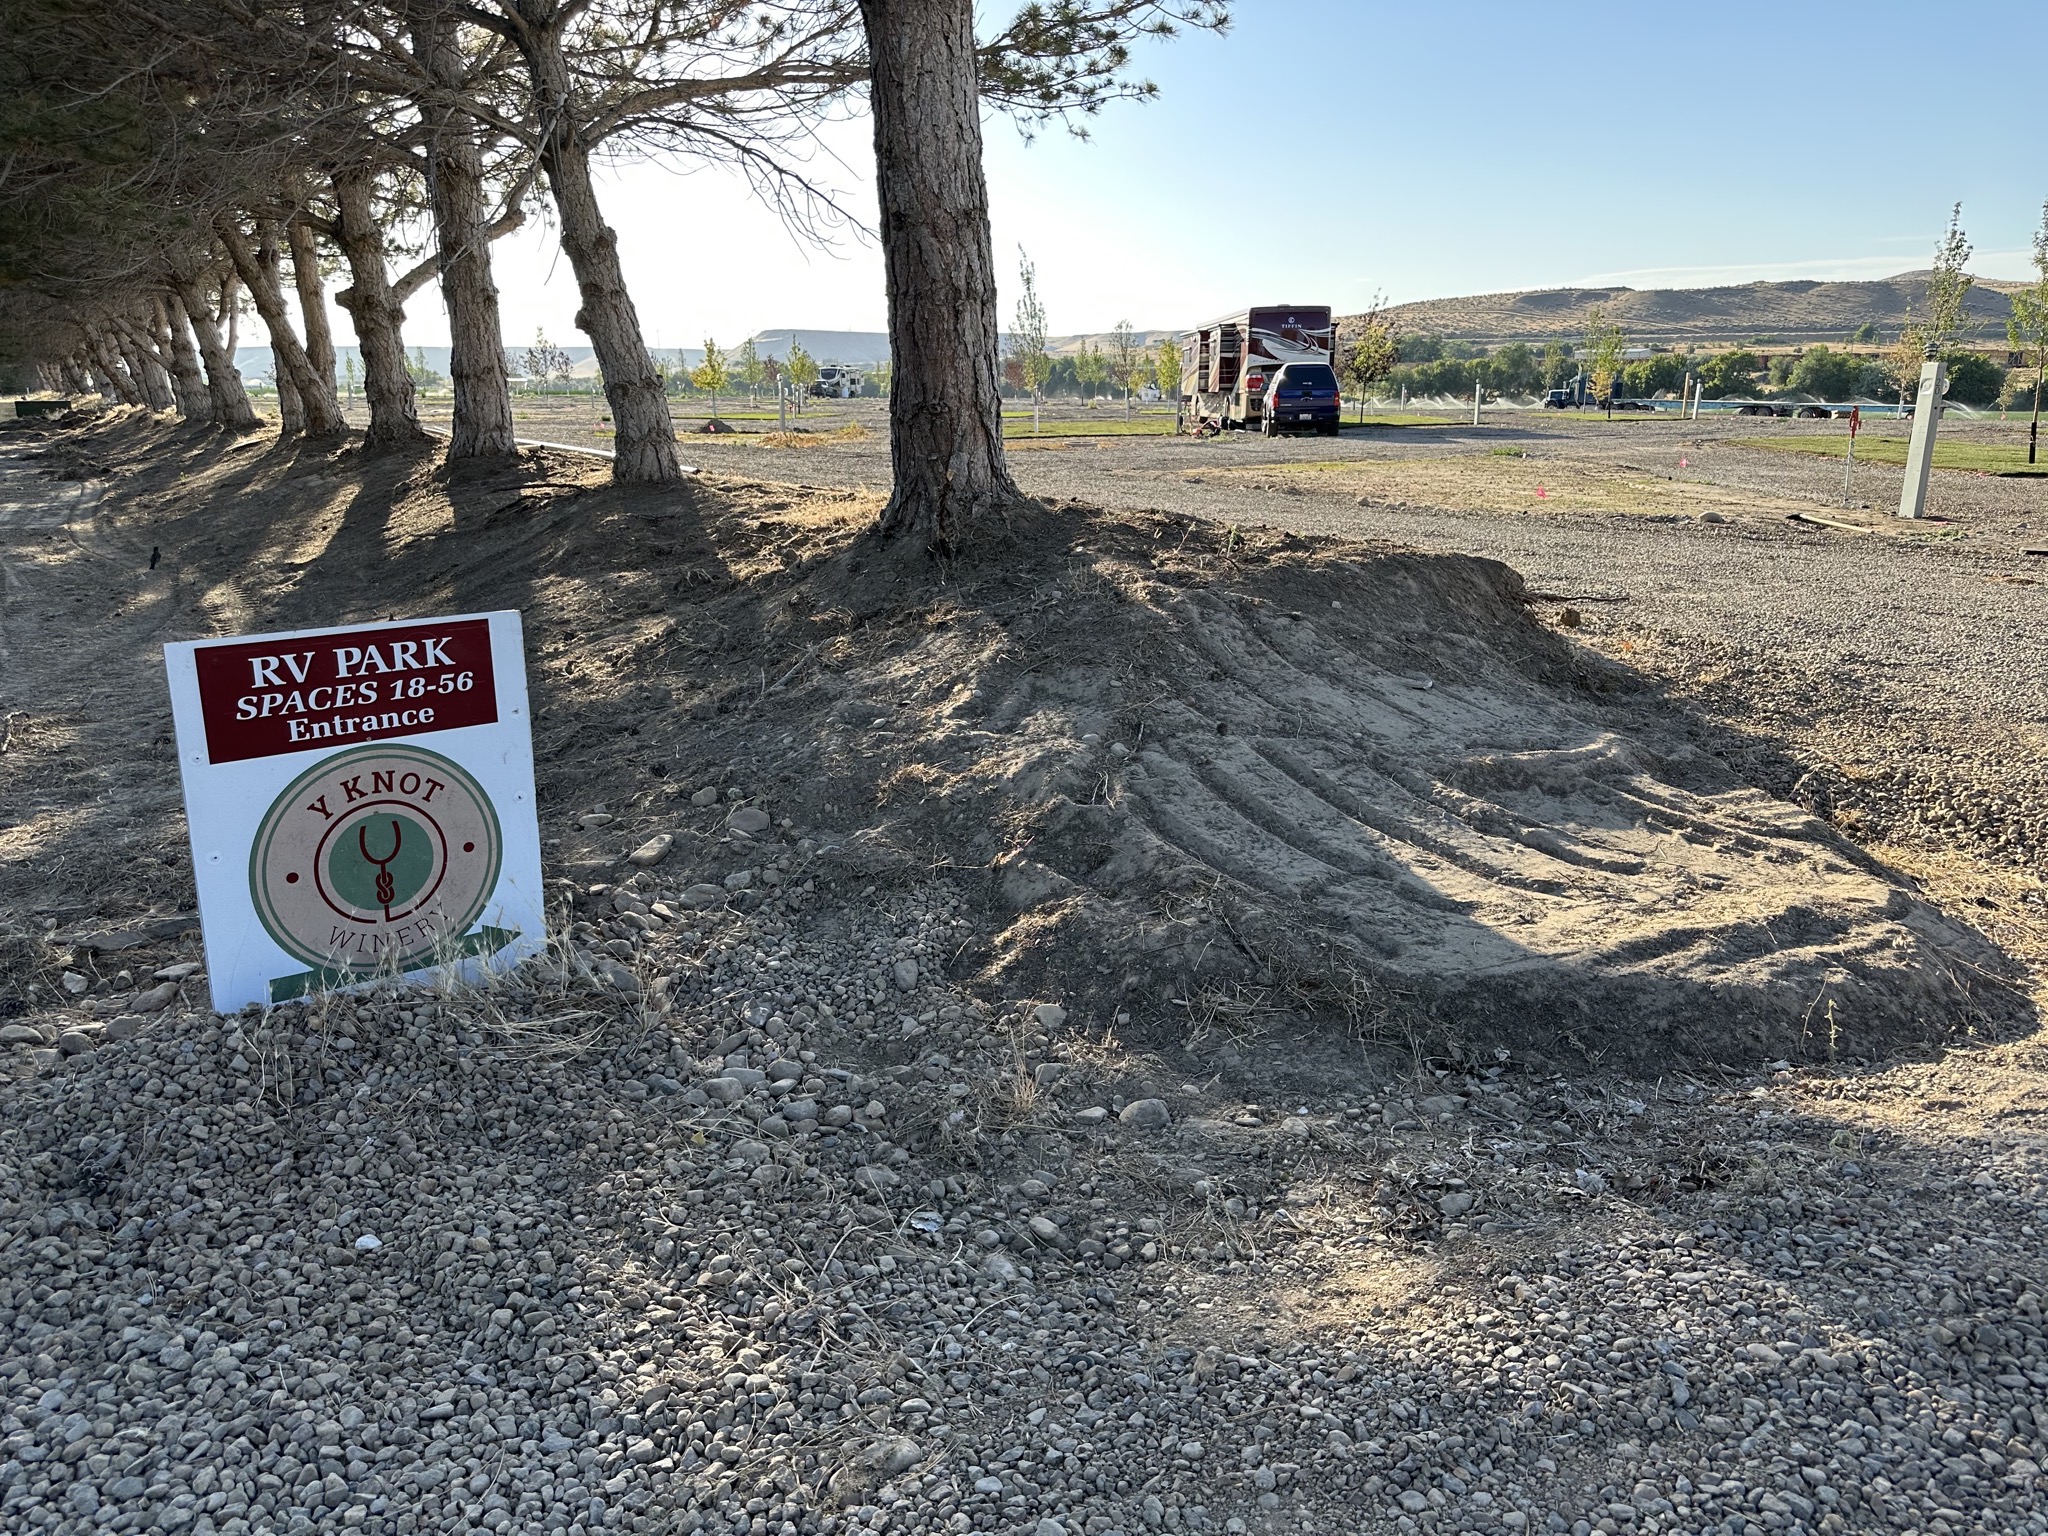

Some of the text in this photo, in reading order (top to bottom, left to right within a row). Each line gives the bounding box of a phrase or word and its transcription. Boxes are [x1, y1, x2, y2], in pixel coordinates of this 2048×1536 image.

[248, 636, 456, 688] RV PARK
[236, 671, 474, 721] SPACES 18-56
[288, 706, 435, 742] Entrance
[307, 769, 446, 821] Y KNOT
[329, 902, 450, 953] WINERY
